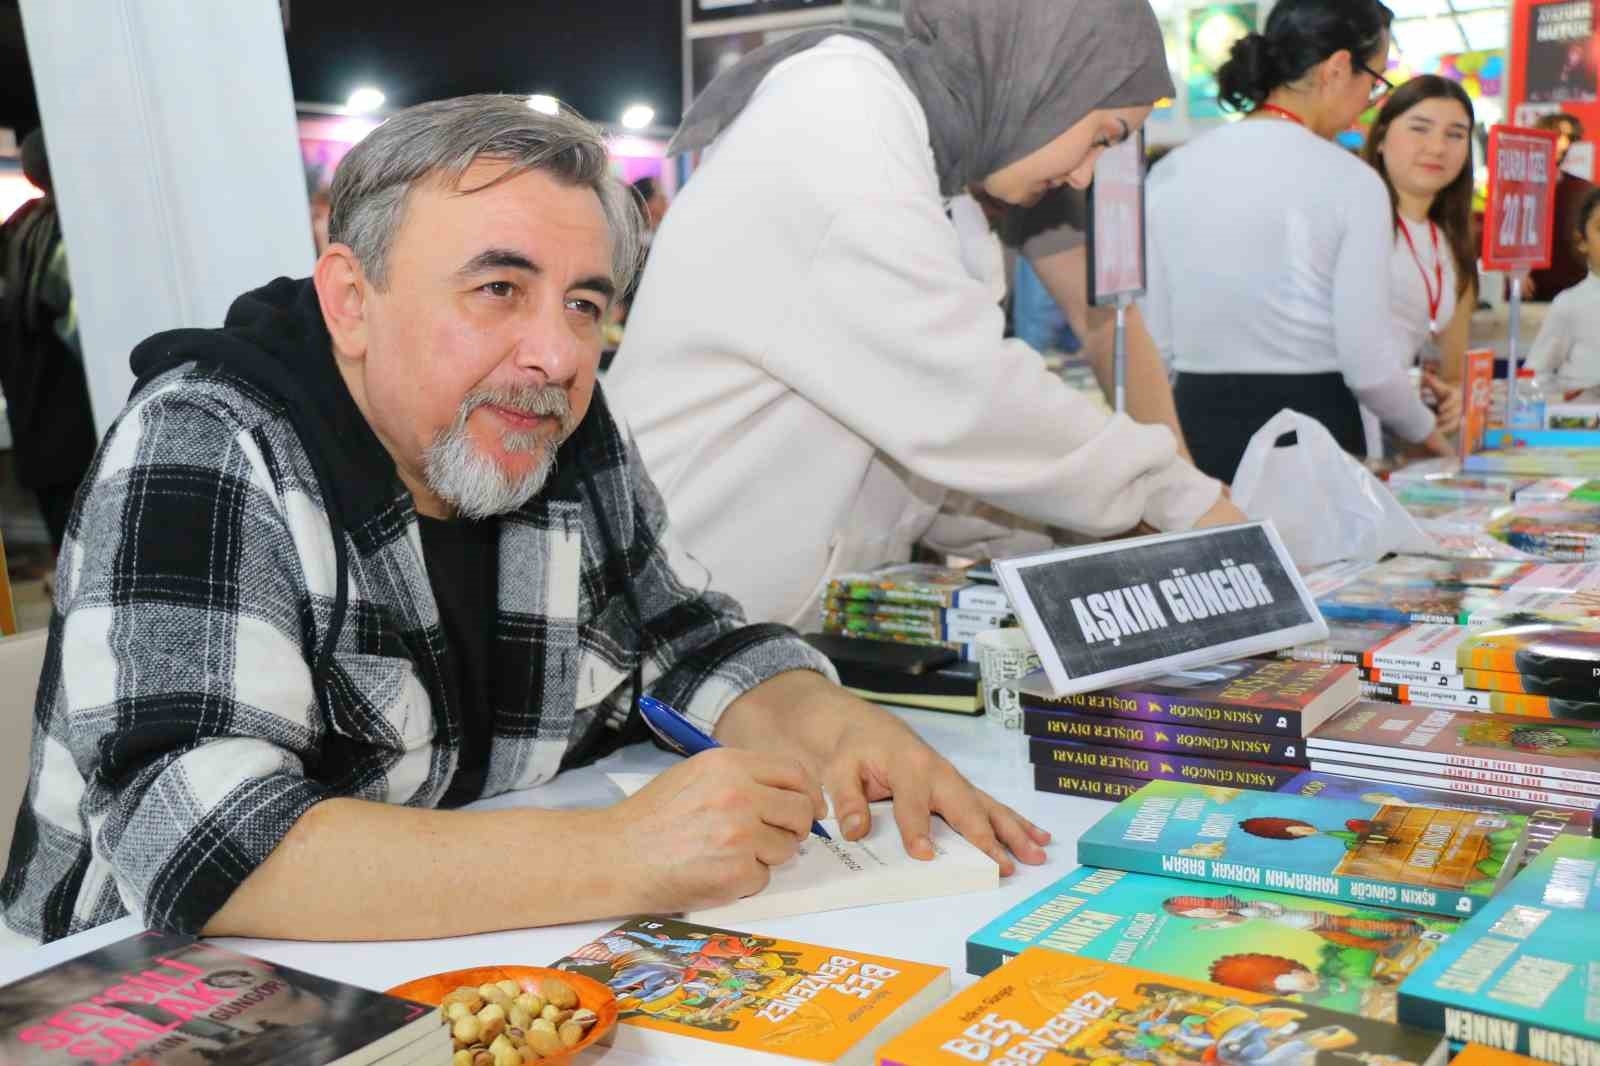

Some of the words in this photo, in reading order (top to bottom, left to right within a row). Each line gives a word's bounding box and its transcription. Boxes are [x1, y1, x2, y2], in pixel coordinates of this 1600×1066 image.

[1499, 194, 1519, 246] 20
[1521, 195, 1539, 246] TL
[1070, 582, 1167, 646] AŞKIN
[1166, 558, 1274, 624] GÜNGÖR
[1087, 694, 1137, 712] DÜŞLER
[1169, 703, 1222, 722] GÜNGÖR
[1223, 709, 1263, 725] AŞKIN
[1047, 720, 1091, 735] DİYARI
[1093, 724, 1144, 742] DÜŞLER
[1176, 733, 1229, 751] GÜNGÖR
[1232, 739, 1272, 755] AŞKIN
[1053, 749, 1096, 764] DİYARI
[1099, 754, 1149, 772] DÜŞLER
[1182, 764, 1233, 783] GÜNGÖR
[1236, 769, 1276, 787] AŞKIN
[1058, 776, 1101, 792] DİYARI
[1104, 782, 1136, 797] ŞLER
[1161, 854, 1206, 876] BABAM
[1211, 862, 1260, 885] KORKAK
[1265, 870, 1339, 894] KAHRAMAN
[1350, 882, 1397, 904] GÜNGÖR
[1401, 887, 1436, 907] AŞKIN
[1038, 910, 1121, 953] ANNEM
[755, 954, 858, 1024] BENZEMEZ
[830, 963, 901, 1000] BEŞ
[19, 955, 205, 1051] SEVGİLİ
[69, 980, 239, 1066] SALAK
[1444, 1007, 1519, 1052] ANNEM
[941, 1013, 1031, 1061] BEŞ
